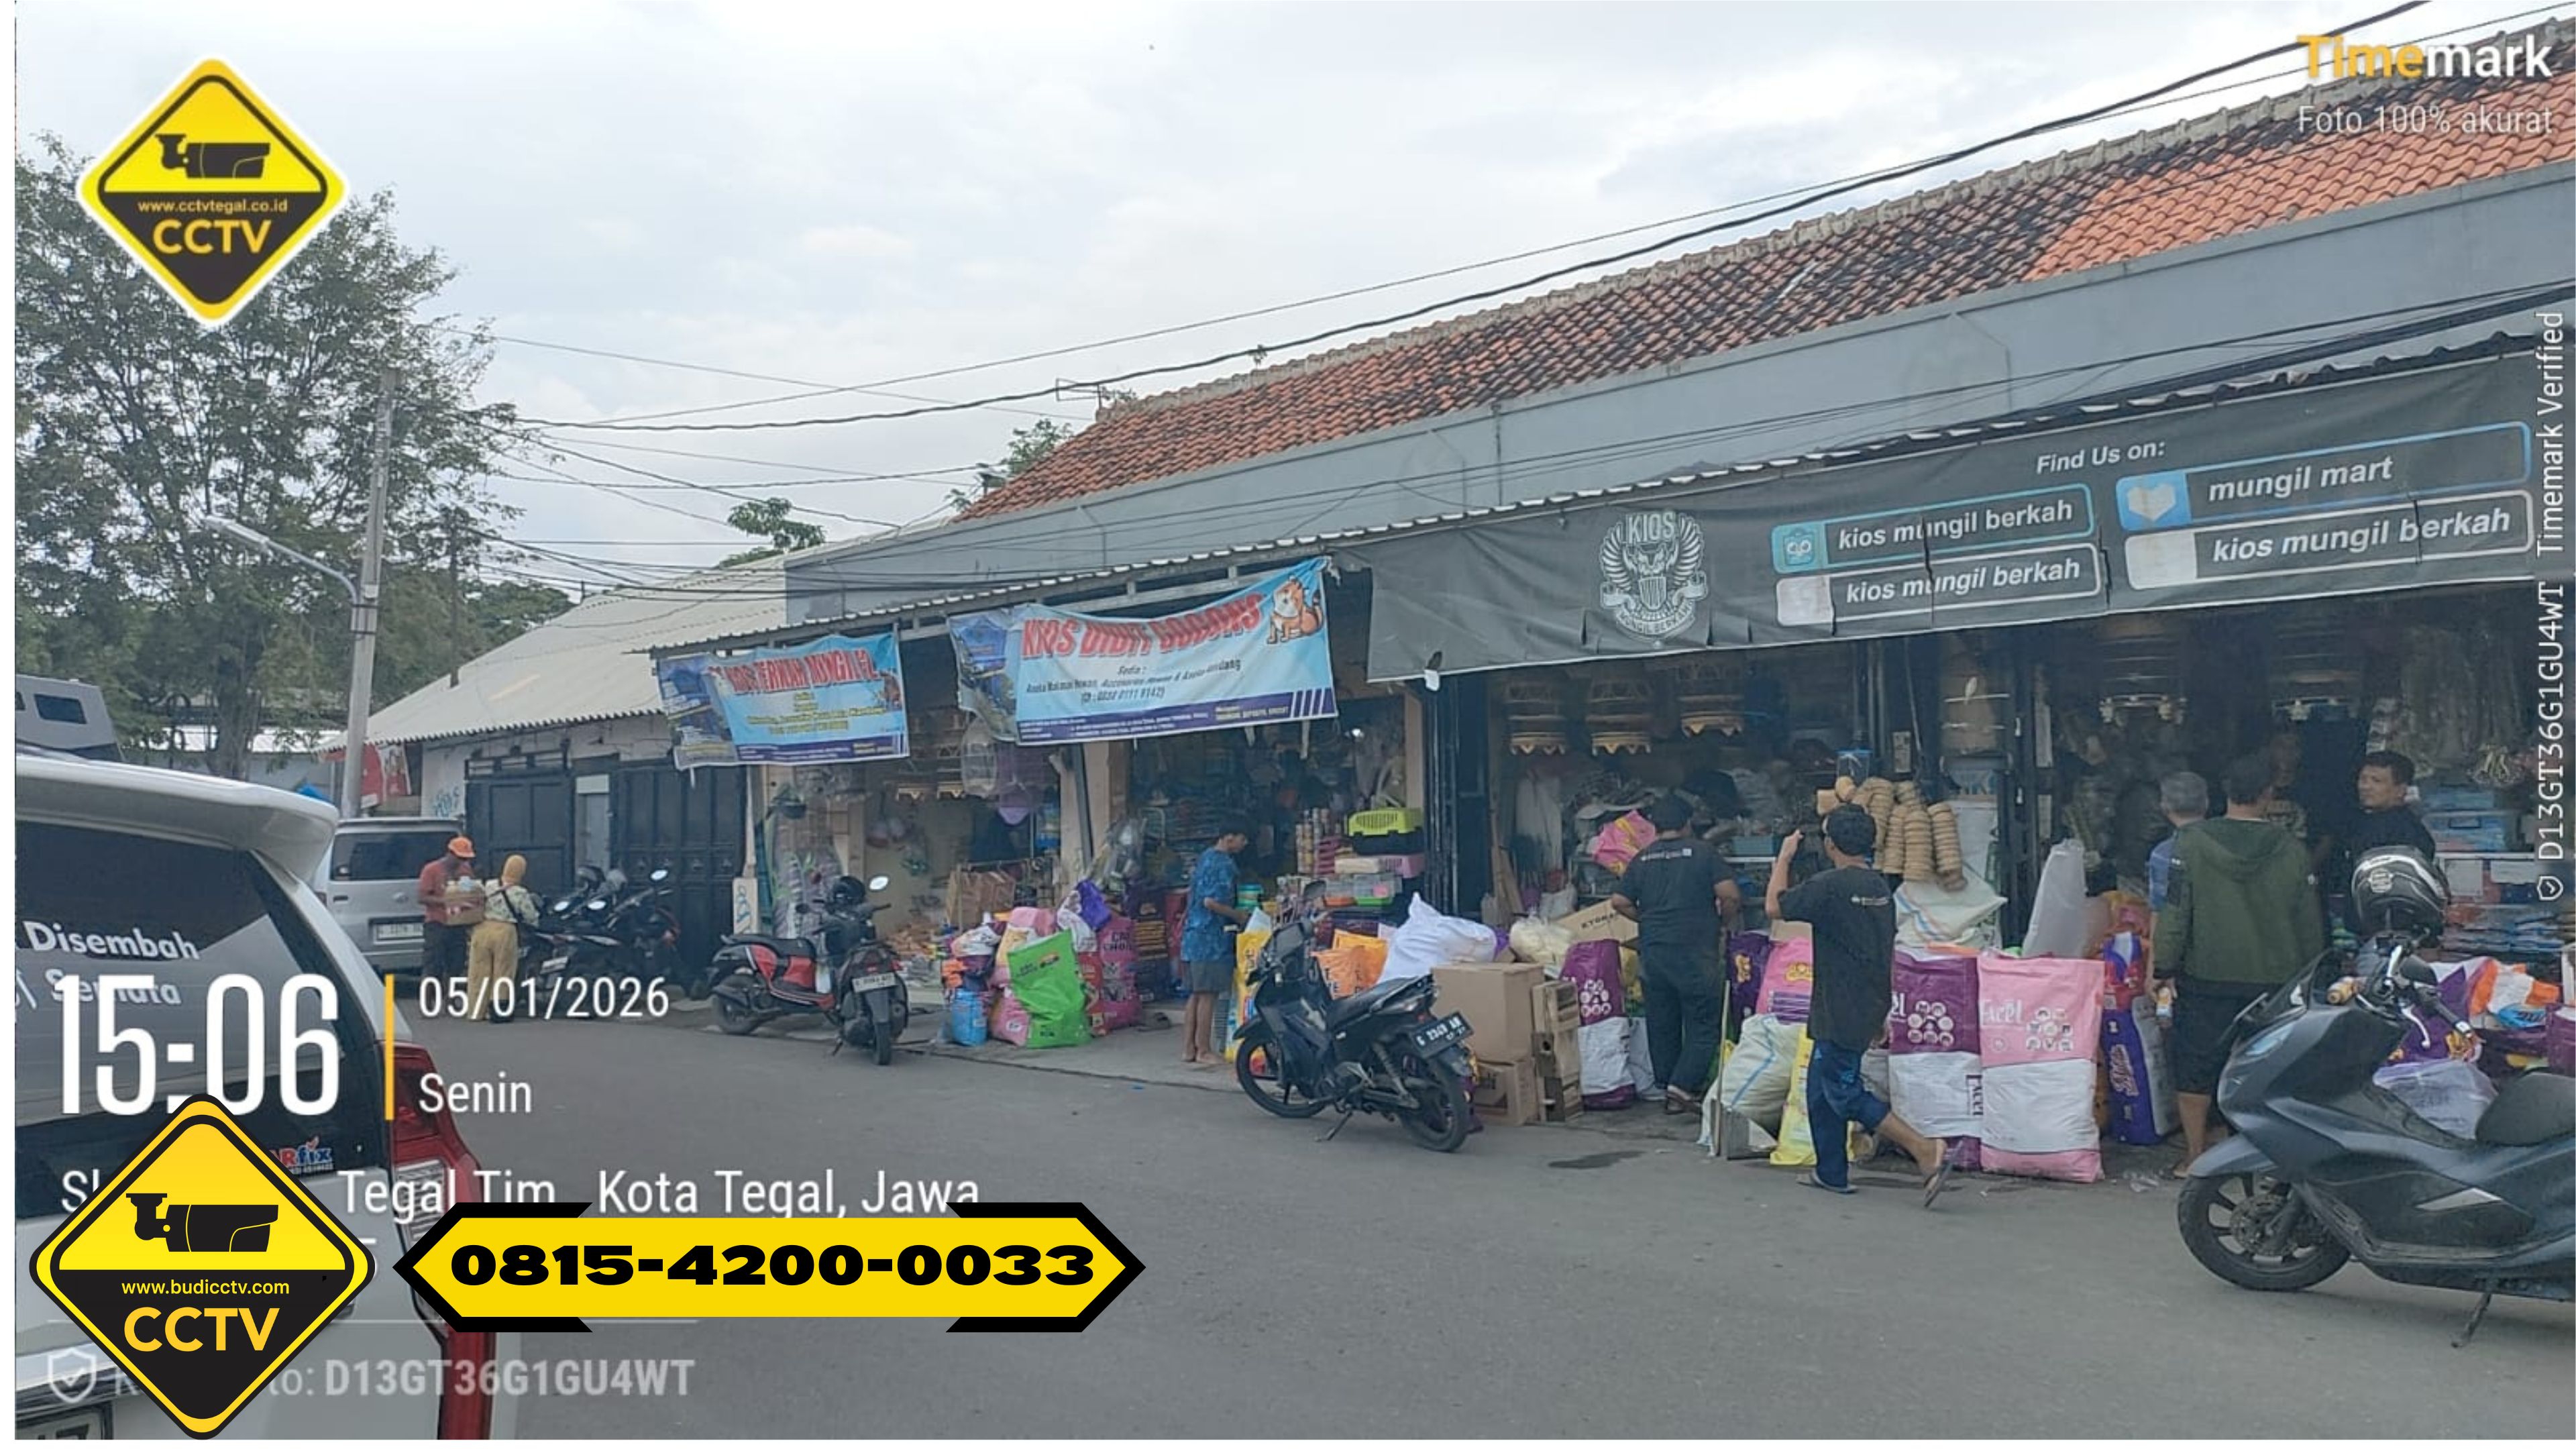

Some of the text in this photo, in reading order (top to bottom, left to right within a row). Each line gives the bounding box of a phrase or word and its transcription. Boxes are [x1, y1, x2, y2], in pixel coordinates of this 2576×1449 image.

[2037, 440, 2165, 475] Find Us on:
[2208, 455, 2394, 502] mungil mart
[1629, 512, 1676, 544] KIOS
[1839, 498, 2073, 550] kios mungil berkah
[2213, 508, 2511, 563] kios mungil berkah
[1847, 557, 2080, 604] kios mungil berkah
[23, 920, 201, 960] Disembah
